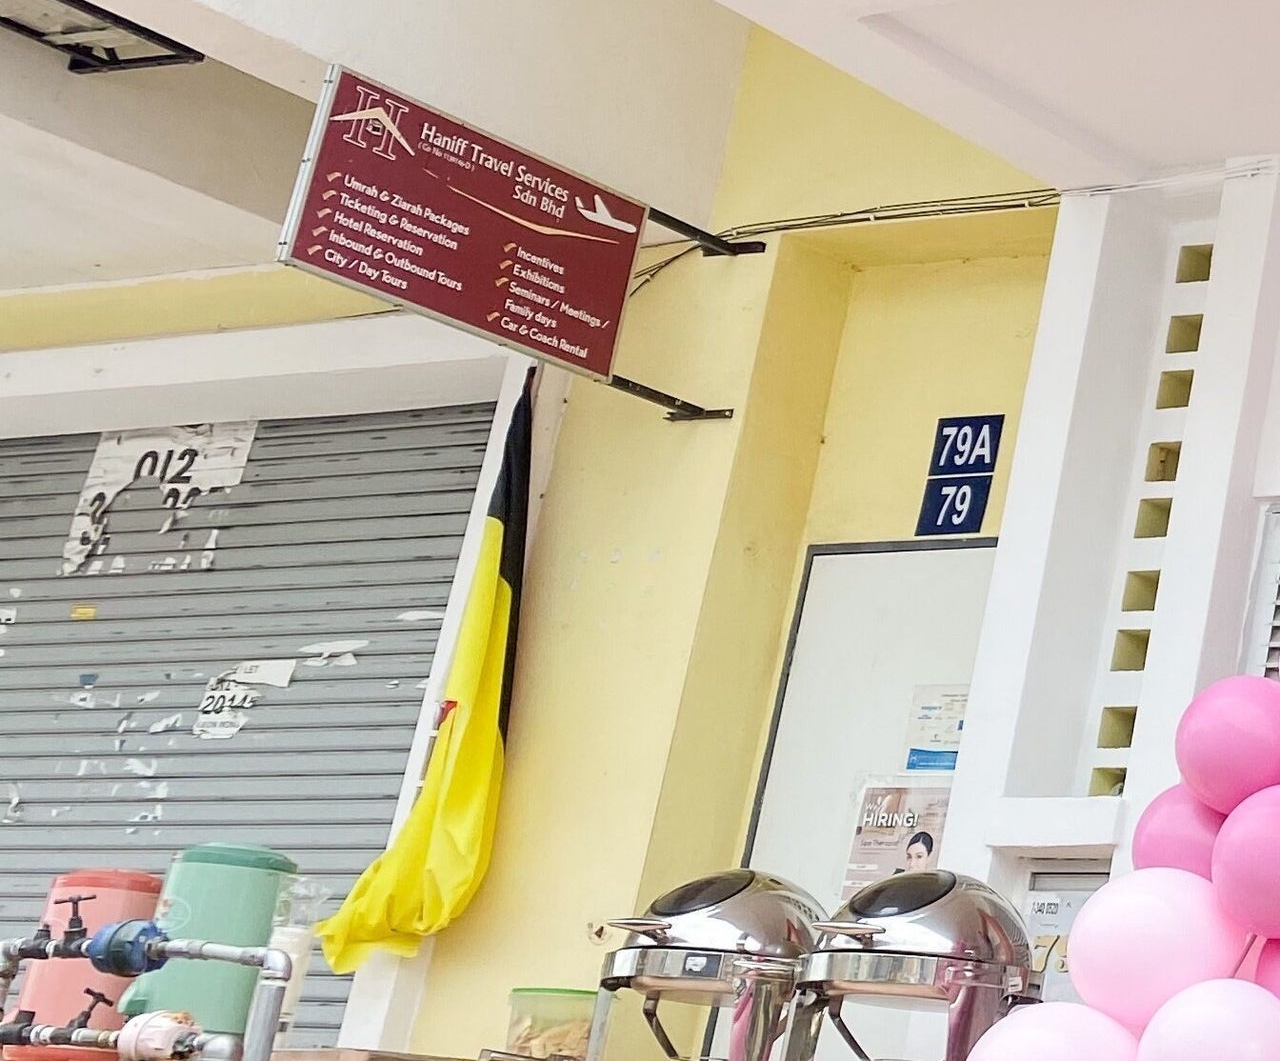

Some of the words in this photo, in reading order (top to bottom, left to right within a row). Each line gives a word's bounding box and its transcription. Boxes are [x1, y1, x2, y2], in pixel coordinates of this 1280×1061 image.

[420, 122, 469, 157] Haniff
[471, 143, 514, 178] Travel
[515, 165, 570, 203] Services
[339, 192, 388, 224] Ticketing
[388, 214, 399, 226] &
[400, 217, 458, 251] Reservation
[344, 174, 379, 199] Umrah
[380, 190, 390, 202] &
[390, 194, 423, 217] Ziarah
[423, 208, 470, 236] Packages
[512, 185, 537, 207] Sdn
[540, 198, 566, 219] Bhd
[333, 210, 364, 233] Hotel
[364, 222, 424, 257] Reservation
[324, 248, 348, 269] City
[358, 261, 380, 281] Day
[380, 269, 409, 290] Tours
[328, 229, 373, 257] Inbound
[373, 248, 384, 260] &
[384, 252, 437, 282] Outbound
[437, 271, 463, 291] Tours
[512, 263, 566, 294] Exhibitions
[516, 246, 565, 275] Incentives
[504, 298, 535, 321] Family
[534, 311, 558, 329] days
[508, 281, 551, 307] Seminars
[559, 301, 601, 328] Meetings
[500, 316, 518, 333] Car
[518, 324, 529, 336] &
[529, 327, 560, 349] Coach
[559, 338, 589, 359] Rental
[938, 425, 992, 467] 79A
[938, 485, 972, 526] 79
[862, 812, 920, 827] HIRING!
